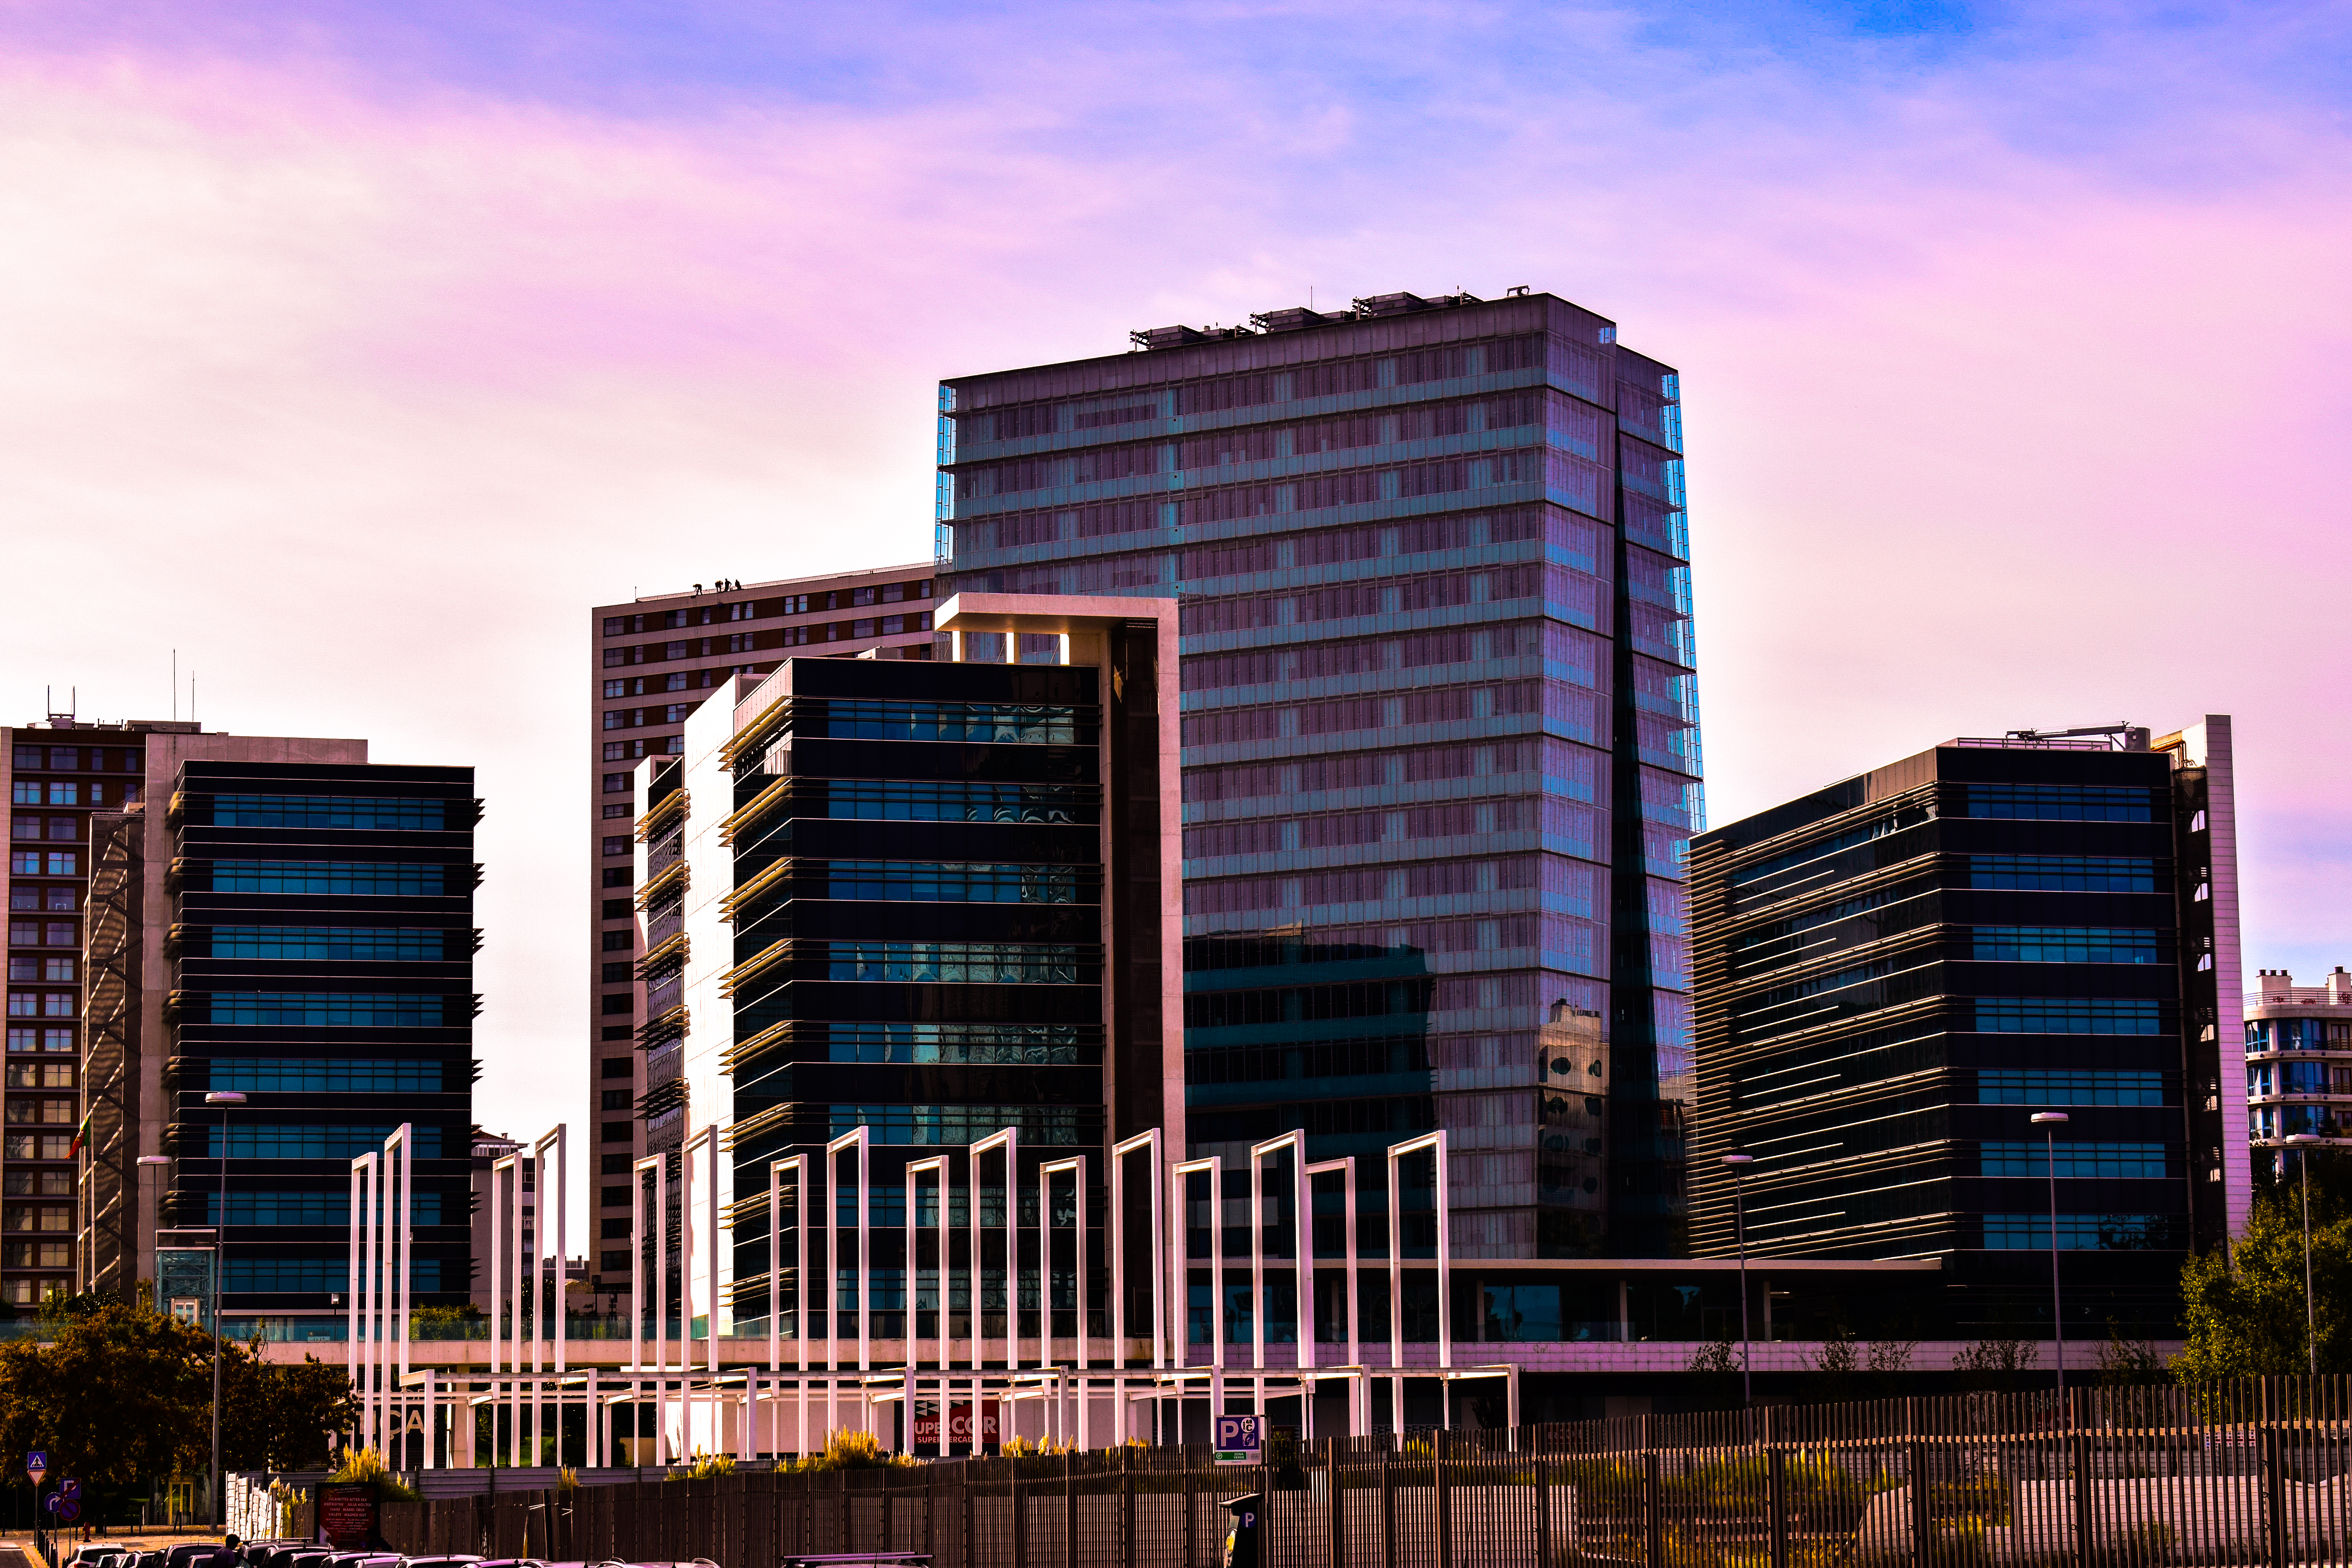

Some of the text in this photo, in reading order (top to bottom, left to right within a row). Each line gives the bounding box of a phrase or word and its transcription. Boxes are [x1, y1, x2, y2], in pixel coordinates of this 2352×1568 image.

[1221, 1421, 1239, 1446] P
[64, 1480, 76, 1497] P
[1245, 1513, 1254, 1527] P
